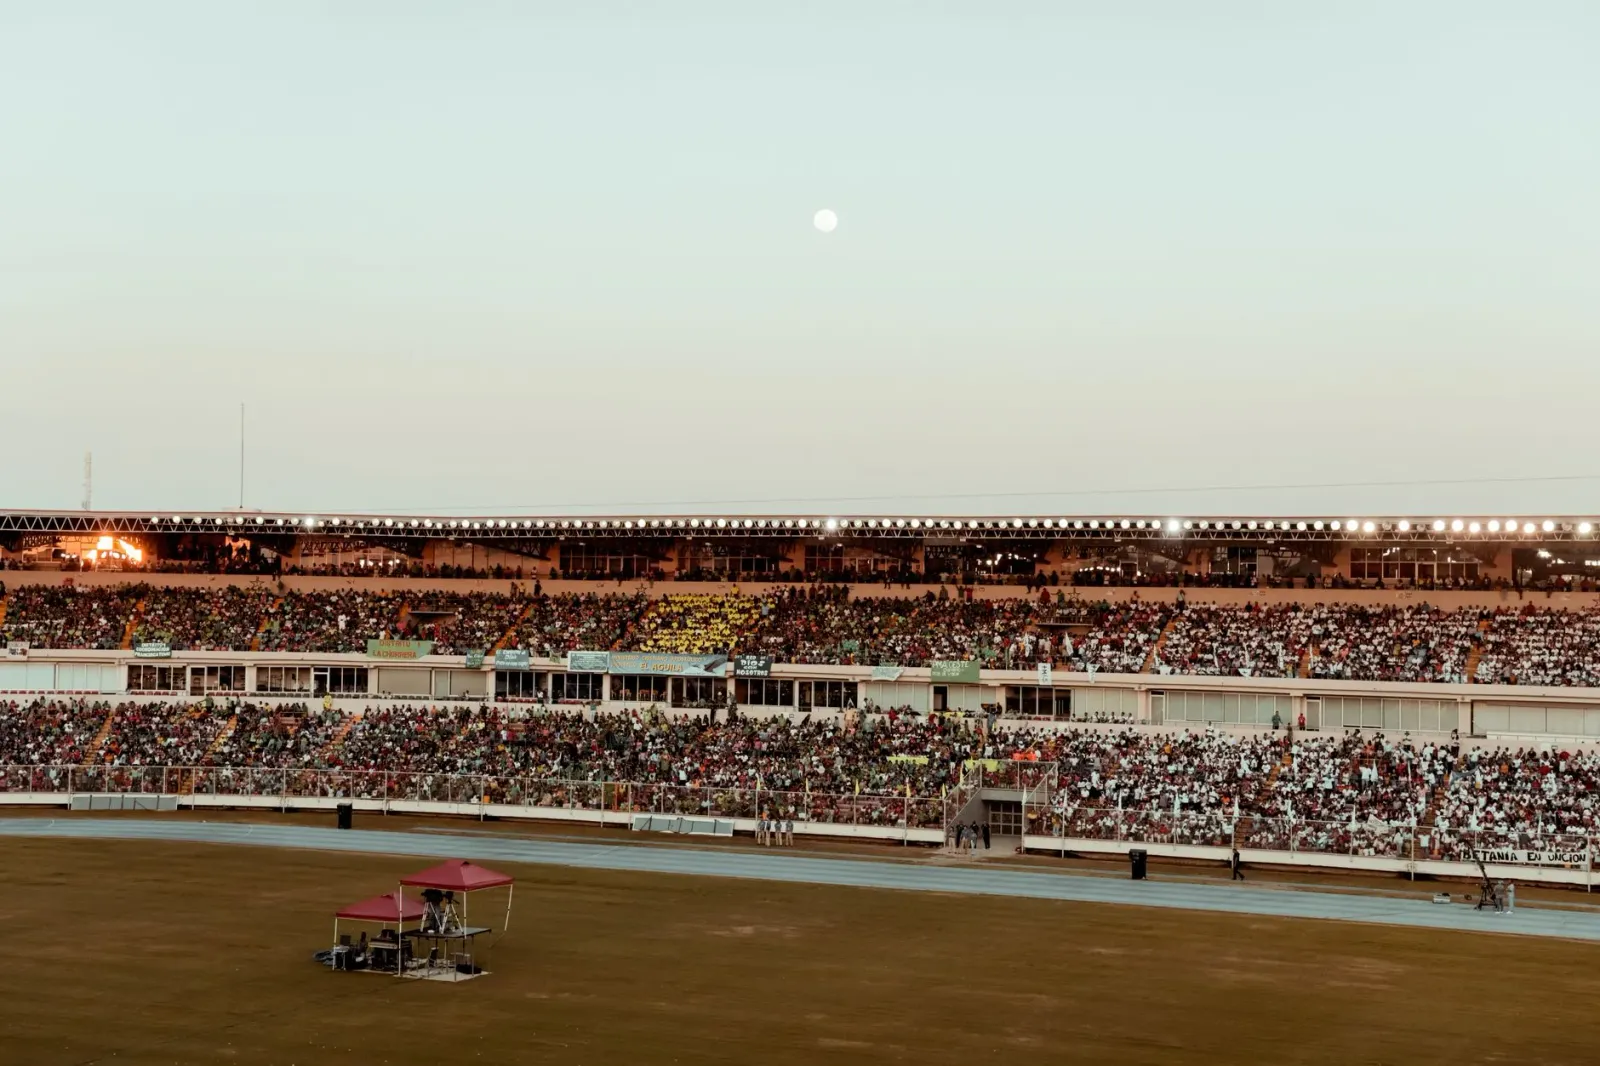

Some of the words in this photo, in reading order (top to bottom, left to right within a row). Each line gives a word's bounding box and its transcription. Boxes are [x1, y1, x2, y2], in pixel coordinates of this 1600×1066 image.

[640, 662, 649, 670] EL
[652, 662, 685, 672] AGUILA
[740, 659, 766, 667] DIOS
[736, 669, 769, 677] NOSOTROS
[1462, 849, 1518, 862] BETANIA
[1527, 851, 1541, 862] EN
